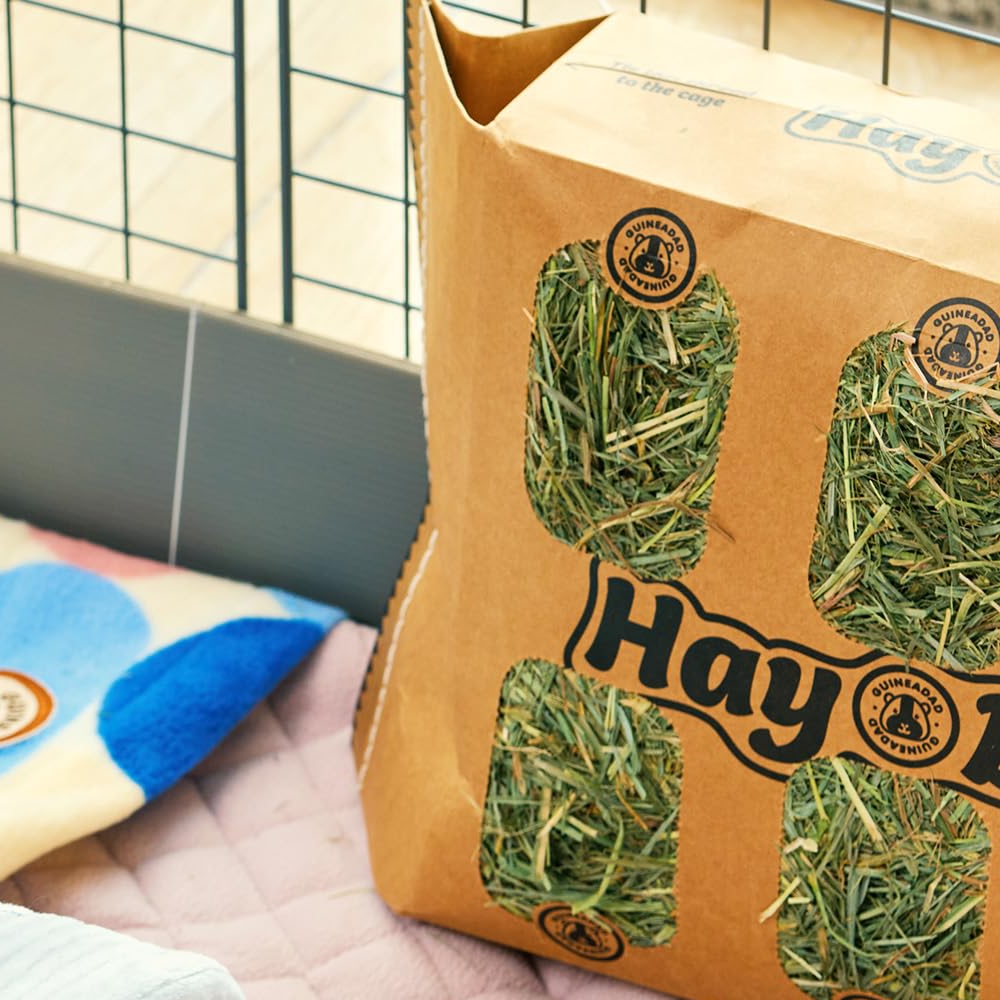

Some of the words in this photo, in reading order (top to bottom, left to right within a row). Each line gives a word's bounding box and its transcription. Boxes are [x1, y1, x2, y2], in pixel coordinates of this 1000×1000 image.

[616, 75, 638, 88] to
[641, 80, 675, 97] the
[677, 90, 727, 108] cage
[625, 220, 685, 253] GUINEADAD
[618, 257, 678, 292] GUINEADAD
[932, 308, 995, 343] GUINEADAD
[583, 576, 842, 765] Hay
[871, 677, 944, 714] GUINEADAD
[867, 717, 940, 756] GUINEADAD
